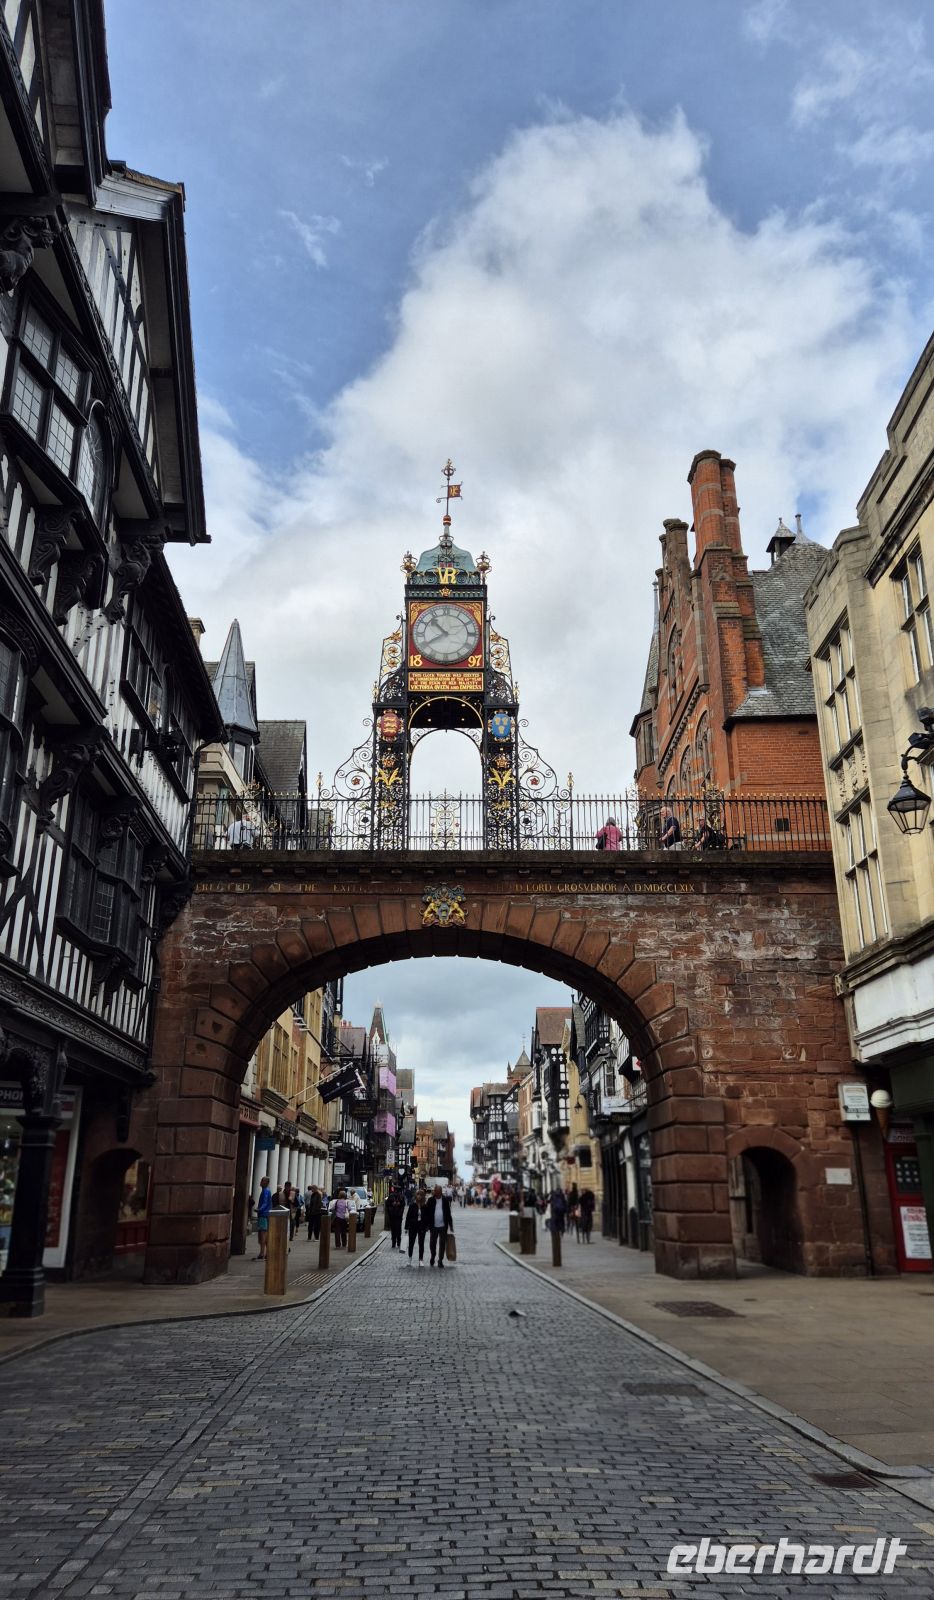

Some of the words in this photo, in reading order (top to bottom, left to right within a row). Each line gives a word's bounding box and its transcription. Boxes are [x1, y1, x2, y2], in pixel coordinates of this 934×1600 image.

[437, 567, 457, 584] VR
[410, 655, 423, 667] 18
[468, 655, 482, 667] 97
[268, 883, 281, 891] AT
[299, 883, 316, 891] THE
[526, 883, 552, 892] LORD
[557, 883, 617, 892] GROSVENOR
